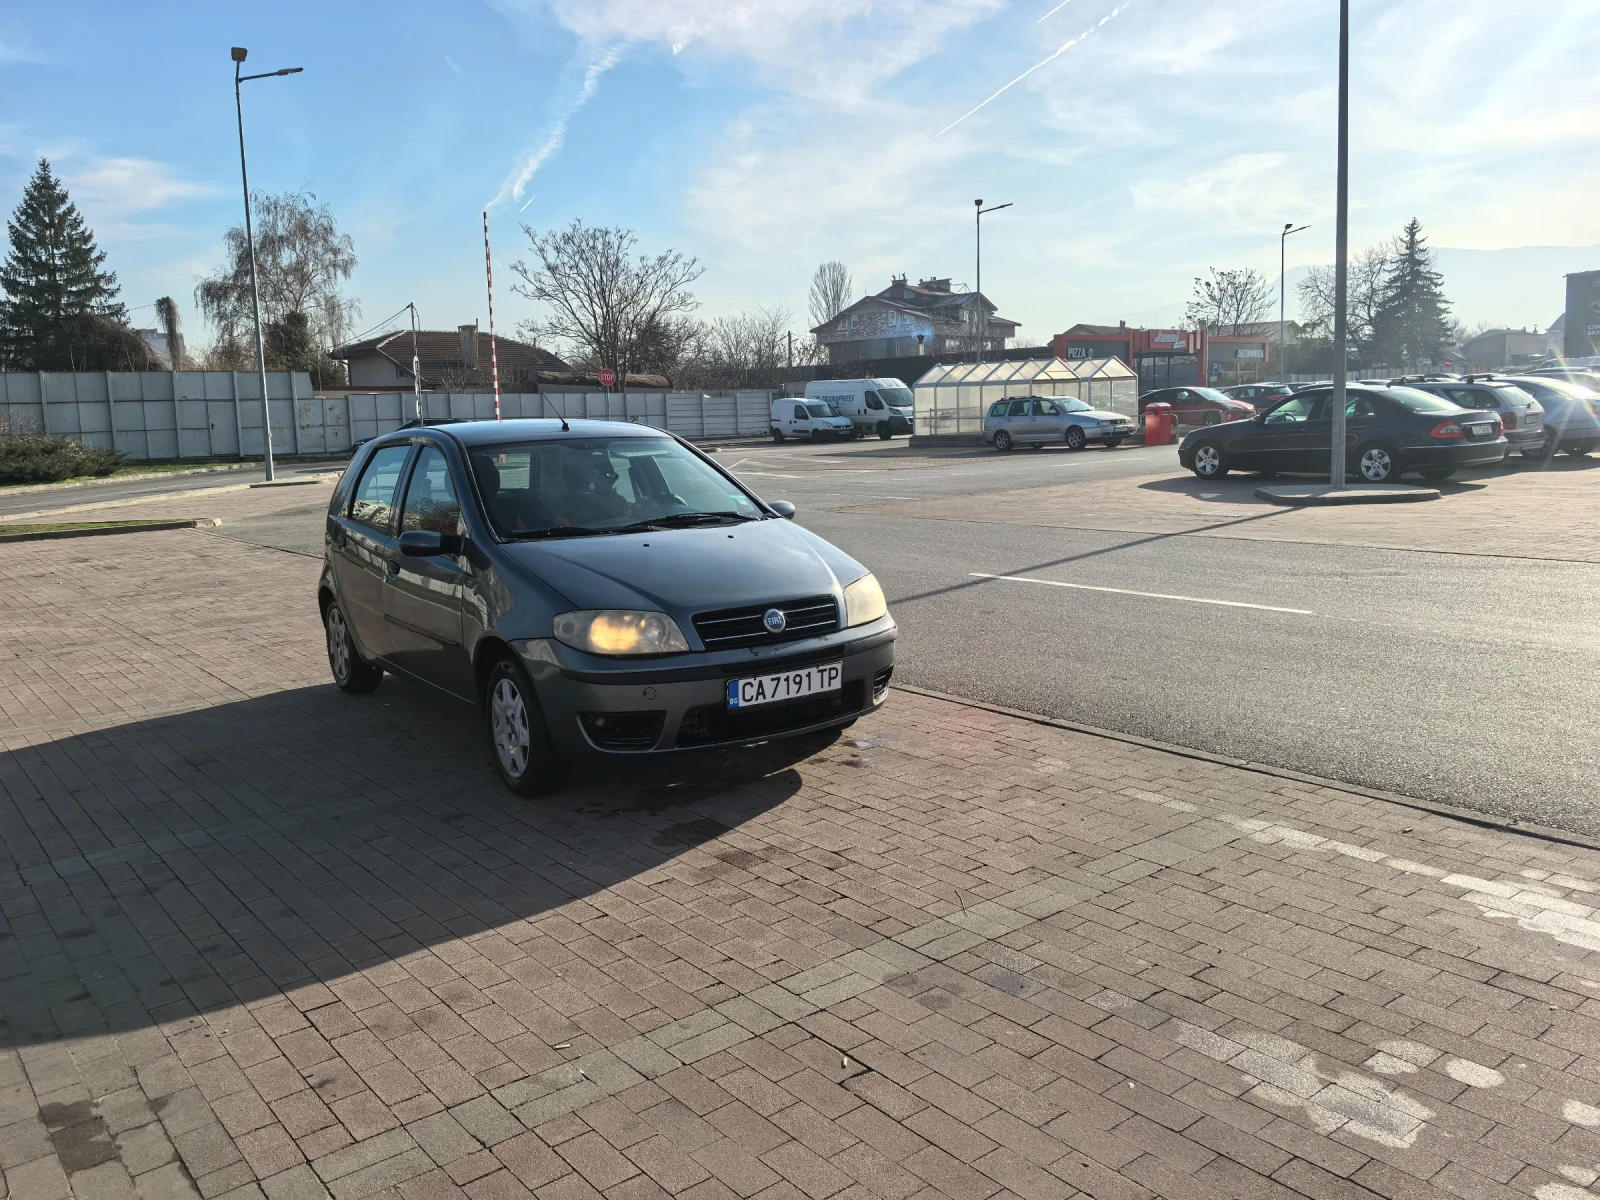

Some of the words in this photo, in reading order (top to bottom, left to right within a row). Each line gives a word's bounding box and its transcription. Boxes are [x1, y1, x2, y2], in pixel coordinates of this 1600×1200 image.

[1068, 347, 1086, 358] PIZZA
[600, 373, 615, 381] STOP
[768, 616, 782, 625] FIAT
[729, 697, 739, 705] BG
